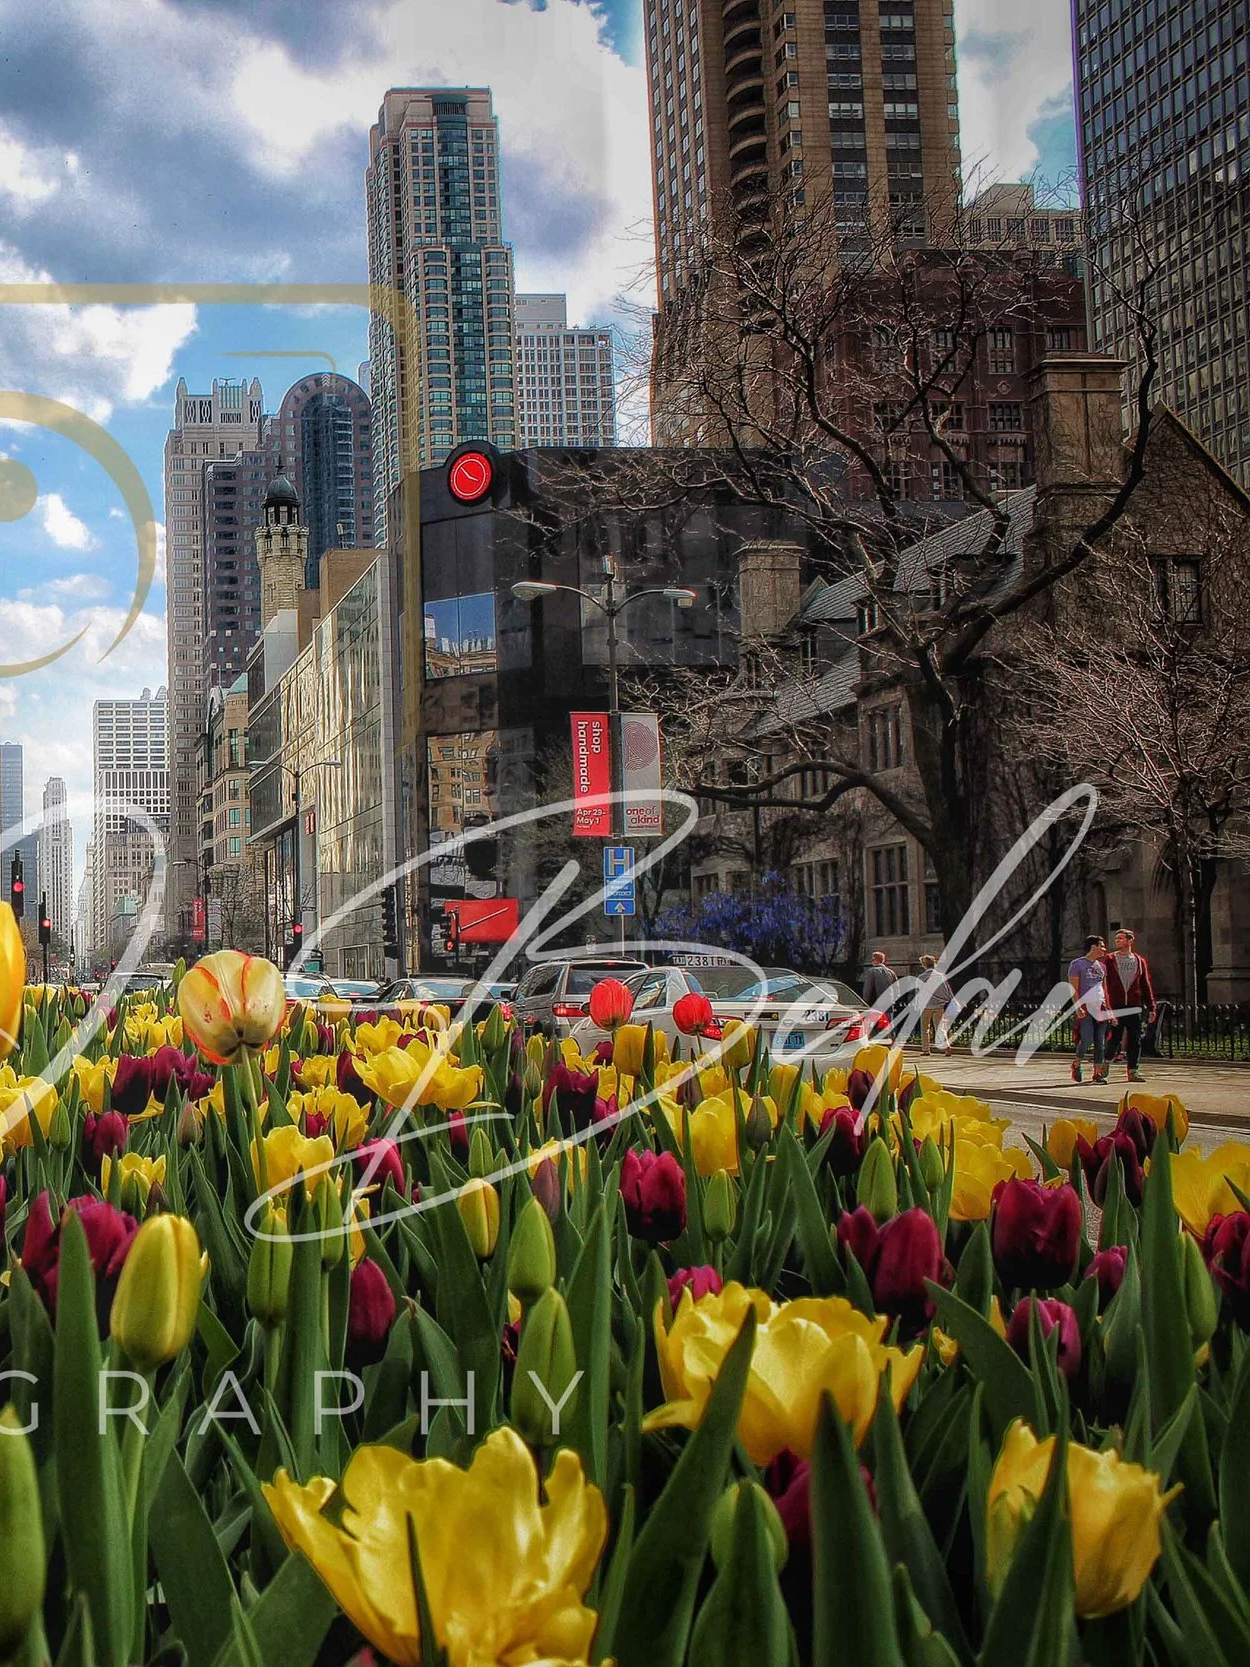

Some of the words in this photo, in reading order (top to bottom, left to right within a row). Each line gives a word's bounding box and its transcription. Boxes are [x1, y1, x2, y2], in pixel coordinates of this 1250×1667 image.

[592, 721, 603, 753] shop
[577, 721, 590, 793] handmade
[577, 808, 592, 817] Apr
[577, 817, 595, 825] May
[608, 849, 630, 876] H
[687, 956, 715, 966] 2381
